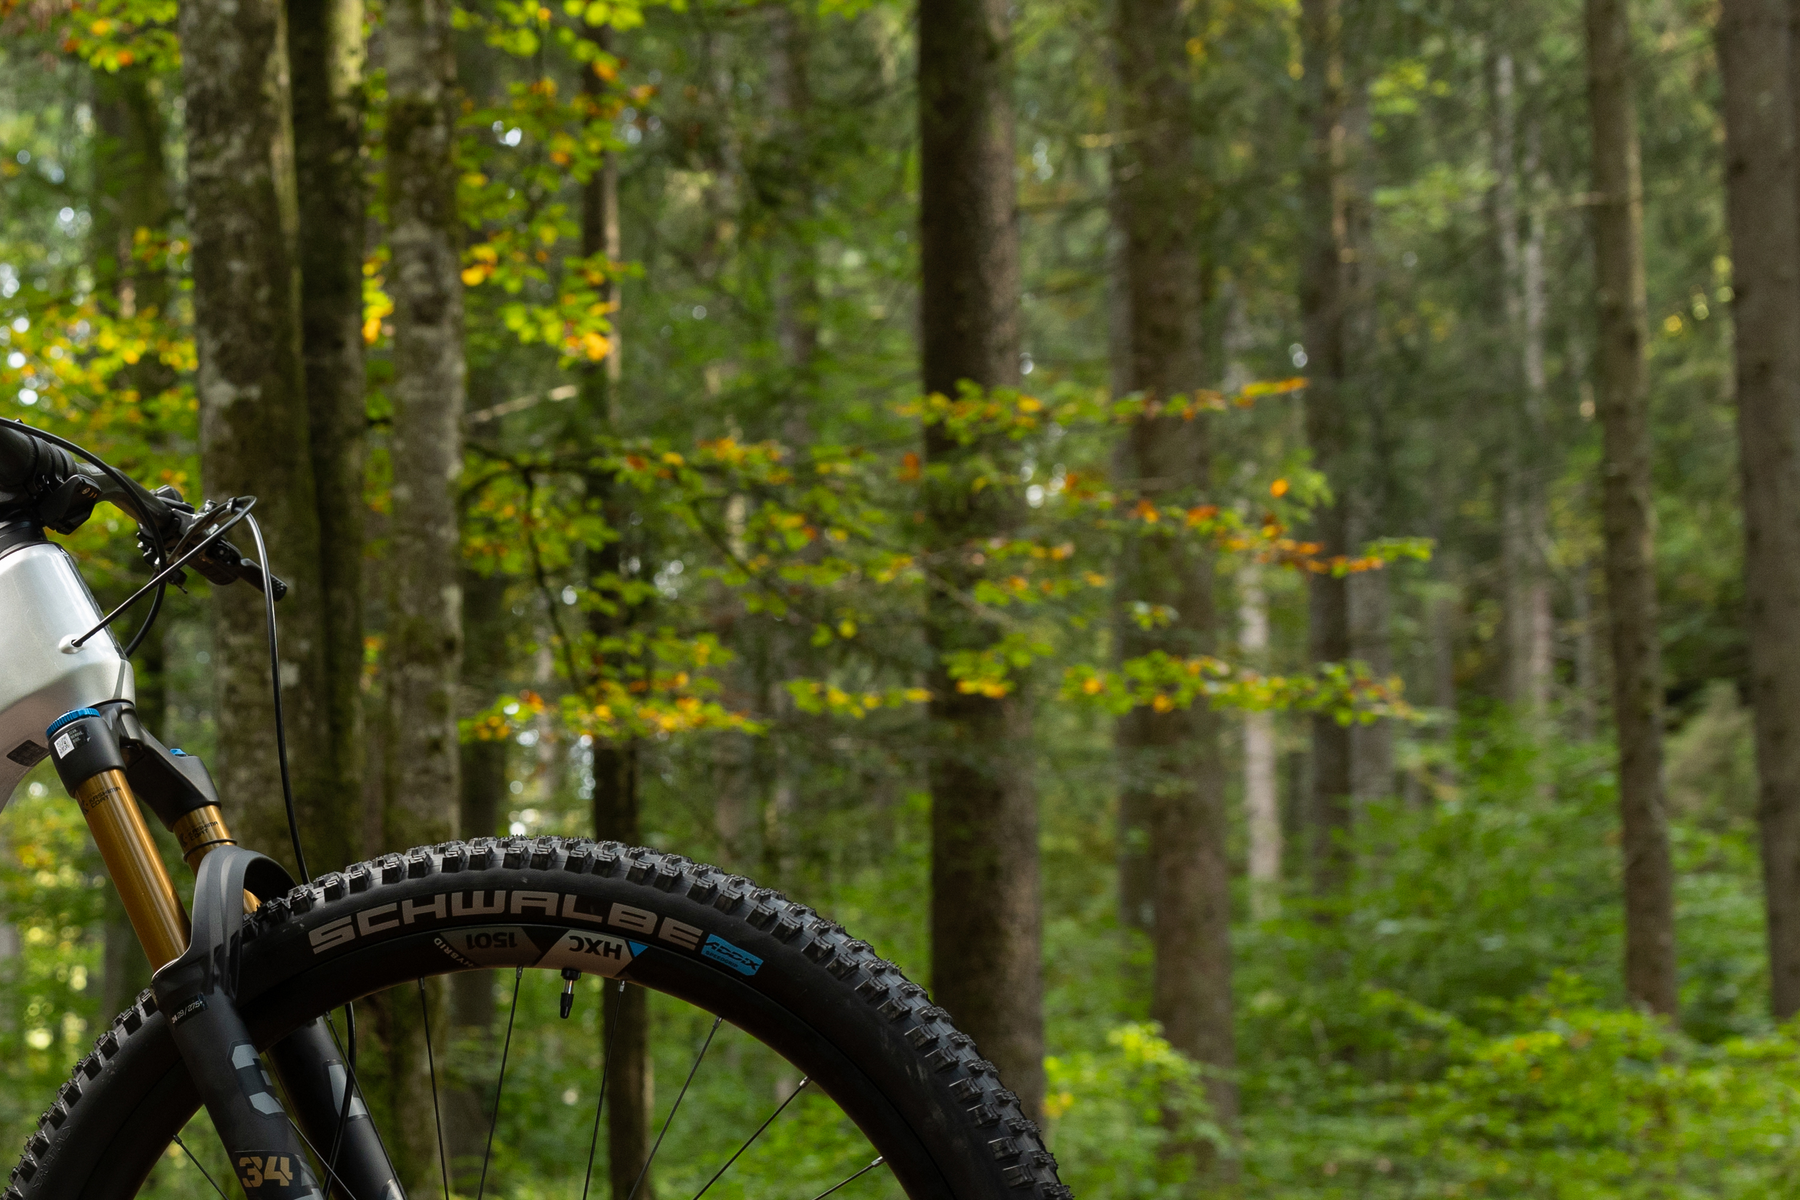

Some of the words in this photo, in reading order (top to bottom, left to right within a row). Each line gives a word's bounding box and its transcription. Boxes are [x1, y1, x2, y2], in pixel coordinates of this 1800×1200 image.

[307, 889, 704, 954] SCHWALBE
[433, 937, 475, 968] HYBRID
[465, 932, 518, 950] 1501
[568, 935, 622, 960] HXC
[705, 941, 760, 971] ADDIX
[705, 950, 739, 968] SPEEDGRIP
[238, 1156, 293, 1188] 34
